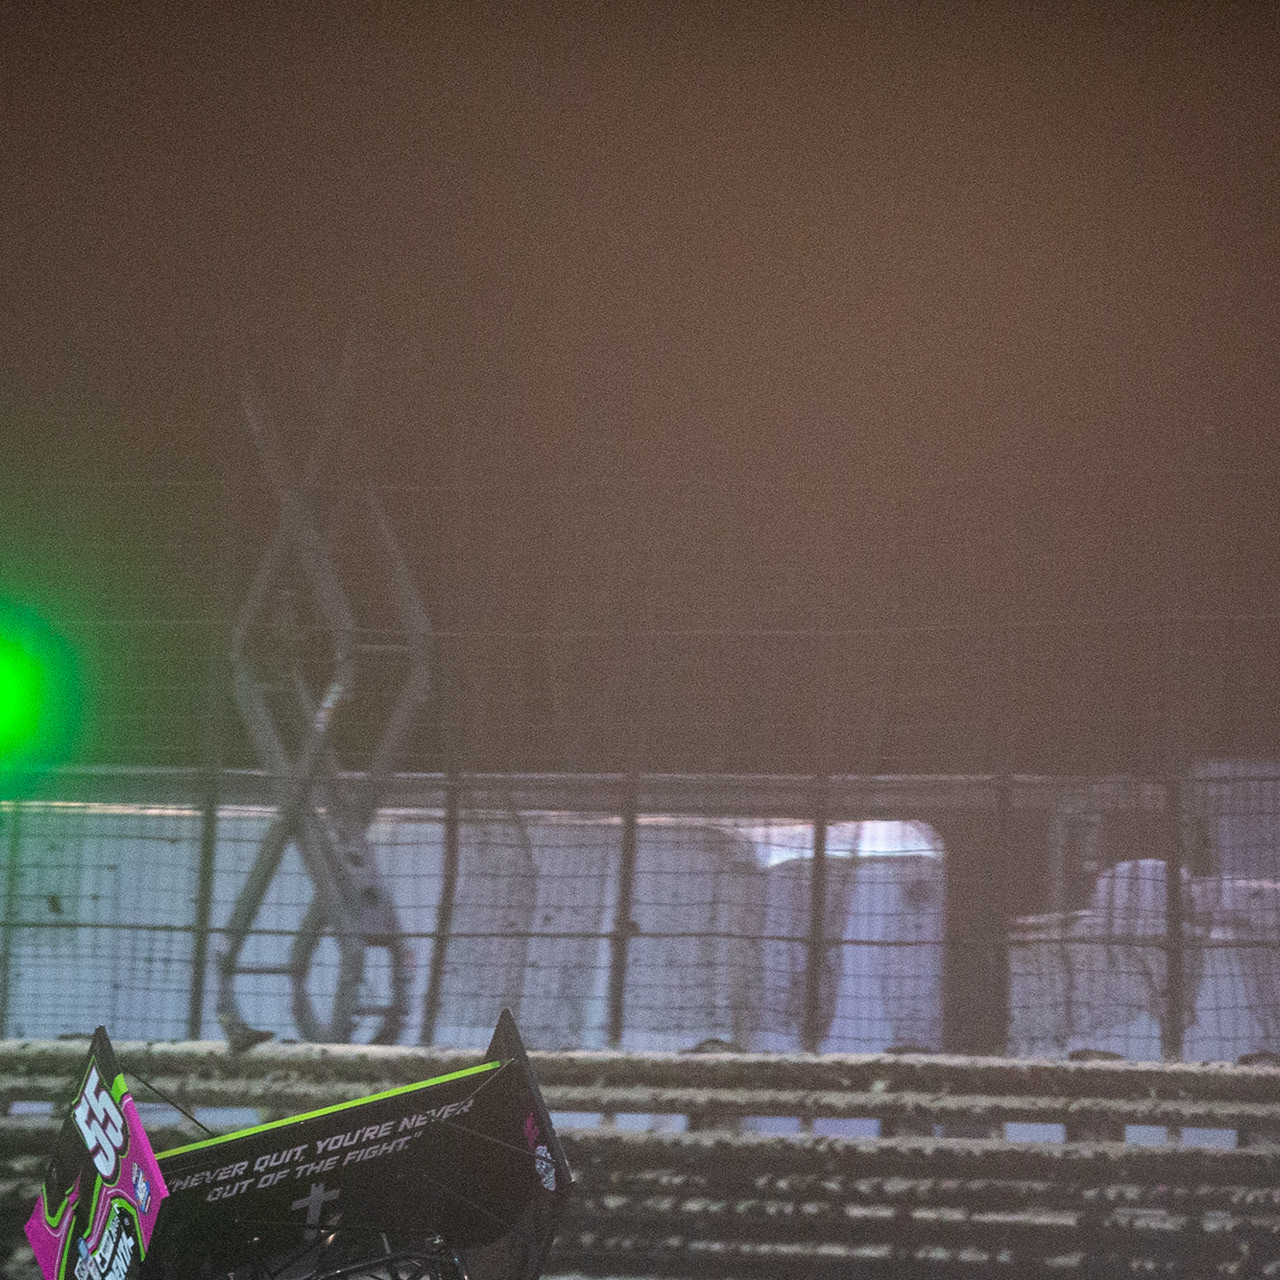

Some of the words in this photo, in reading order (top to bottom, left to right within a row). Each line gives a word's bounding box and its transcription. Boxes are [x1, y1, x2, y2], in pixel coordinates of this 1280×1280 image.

[74, 1064, 125, 1178] 55
[253, 1143, 309, 1173] QUIT,
[316, 1120, 395, 1154] YOU'RE
[398, 1097, 474, 1132] NEVER
[206, 1177, 254, 1202] OUT
[257, 1165, 291, 1188] OF
[295, 1155, 338, 1180] THE
